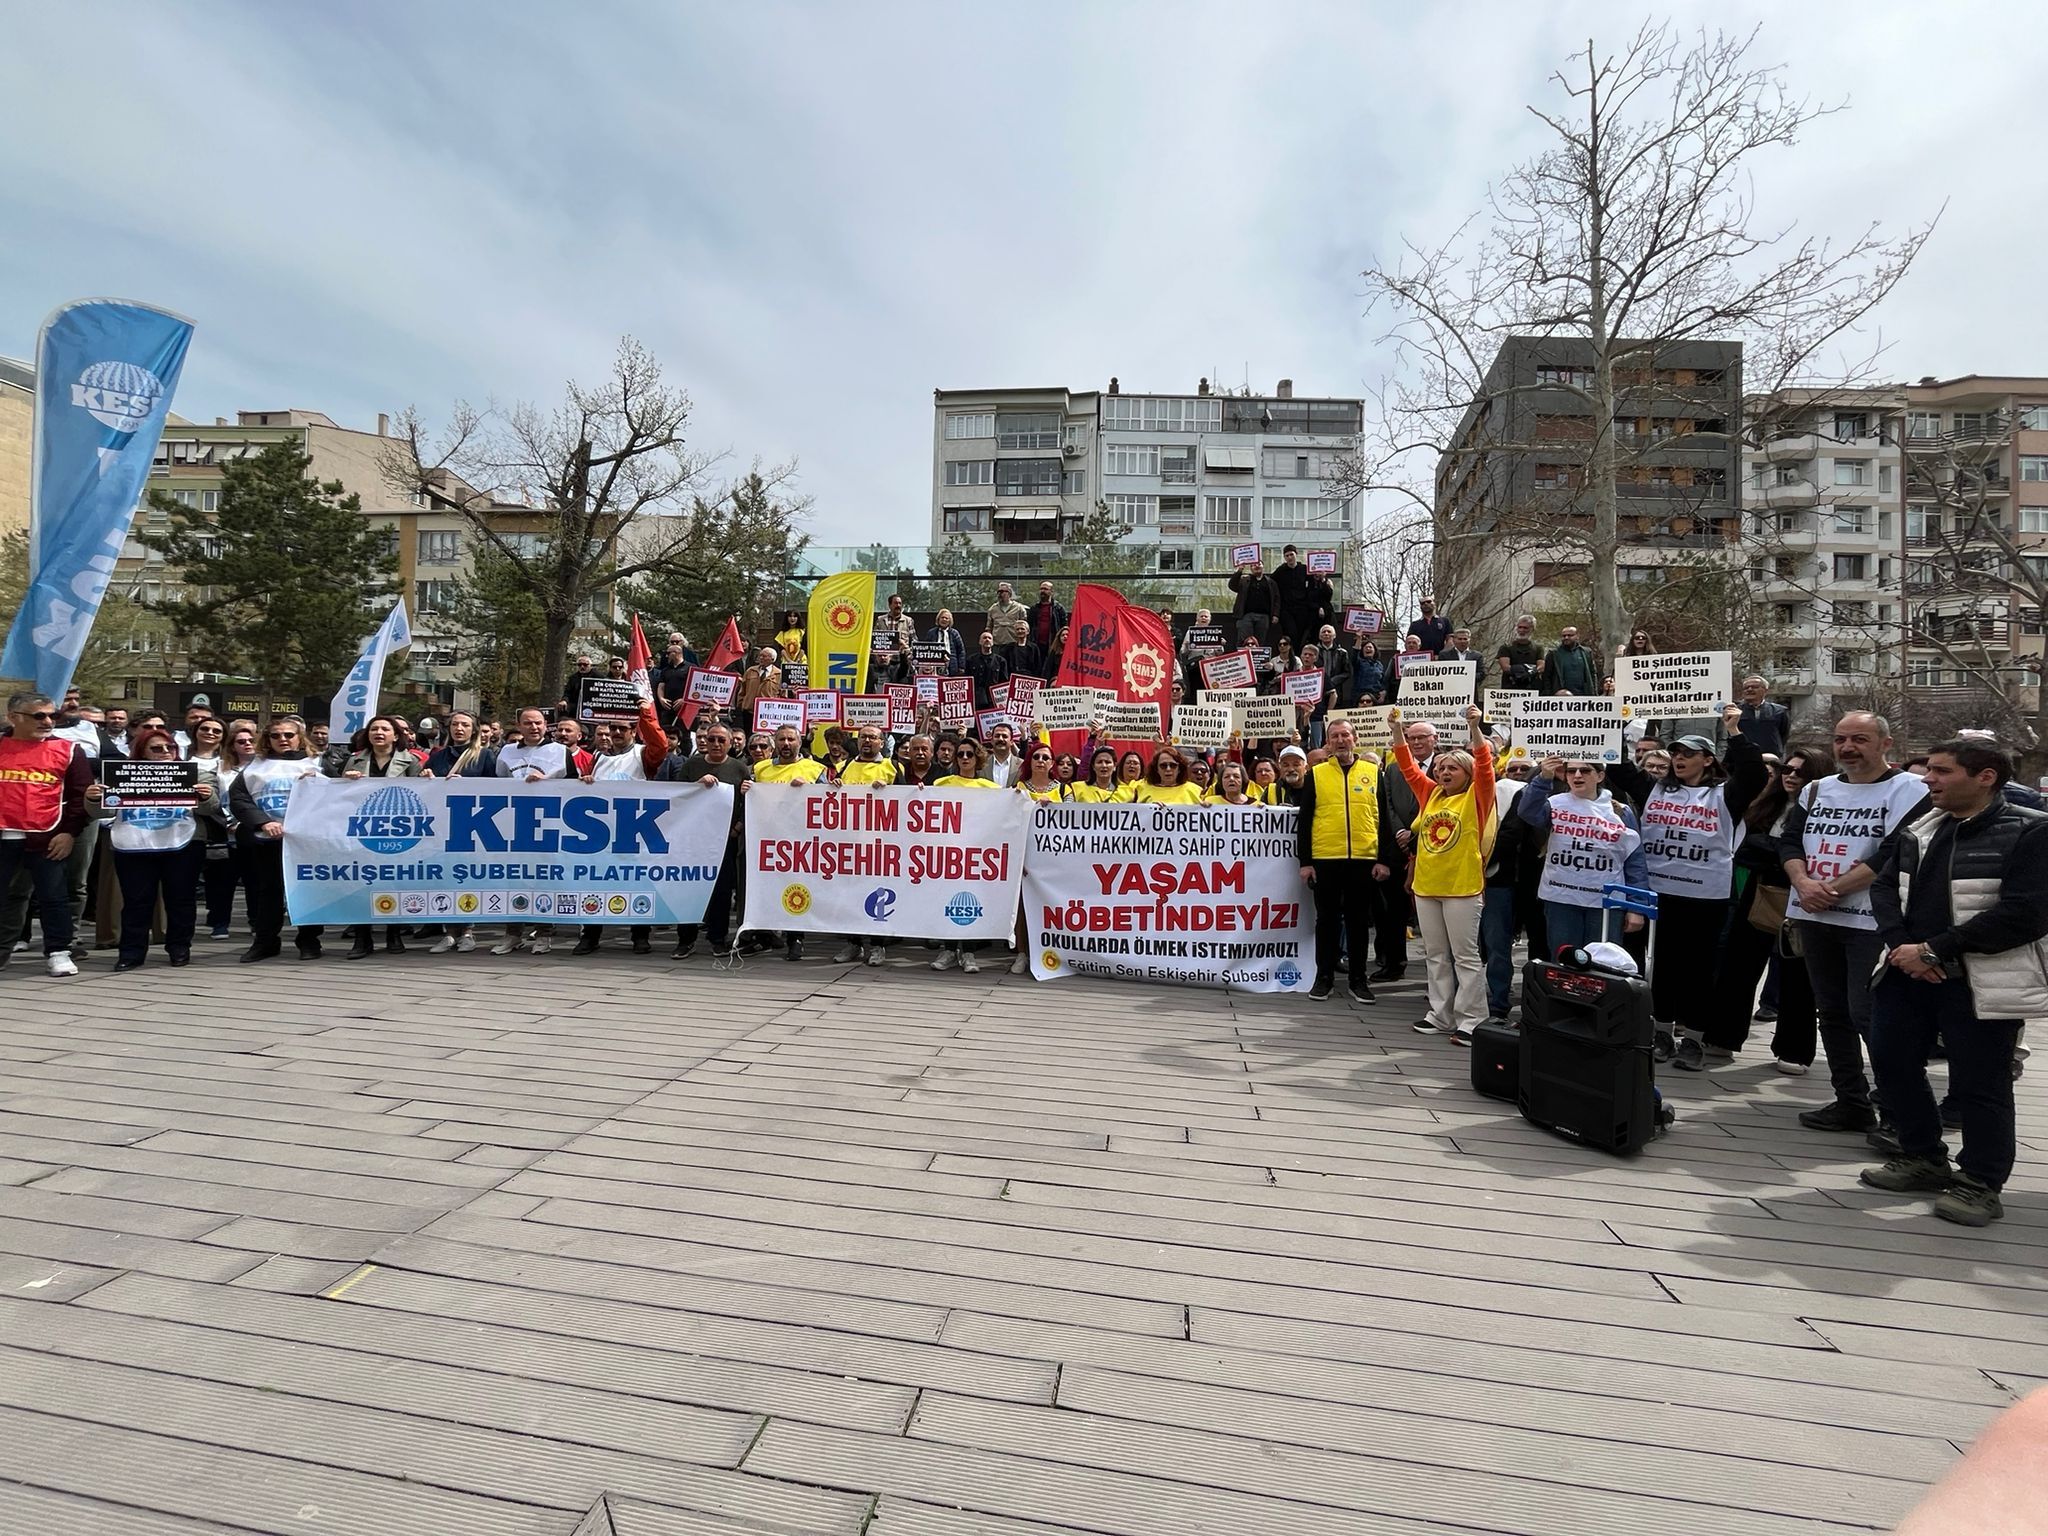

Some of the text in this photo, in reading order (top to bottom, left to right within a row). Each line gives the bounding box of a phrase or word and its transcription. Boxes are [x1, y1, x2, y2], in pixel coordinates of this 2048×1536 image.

[1632, 655, 1711, 669] Bu şiddetin
[828, 652, 859, 694] EN
[1633, 668, 1709, 681] Sorumlusu
[944, 680, 967, 690] YUSUF
[1016, 679, 1039, 690] YUSUF
[1413, 681, 1444, 692] Bakan
[1650, 681, 1692, 692] Yanlış
[891, 688, 911, 698] YUSUF
[946, 689, 966, 701] TEKİN
[1039, 689, 1074, 698] Yaşatmak
[1204, 691, 1232, 703] Vizyon
[1623, 691, 1722, 705] Politikalardır !
[1234, 697, 1269, 708] Güvenli
[1427, 694, 1471, 706] bakıyor!
[1494, 701, 1511, 709] Şidd
[940, 701, 973, 719] İSTİFA
[1053, 705, 1077, 713] Ölmek
[1177, 707, 1228, 717] Okulda Can
[1246, 708, 1282, 719] Güvenli
[1522, 700, 1613, 714] Şiddet varken
[1635, 708, 1651, 718] Eğitim
[1652, 707, 1662, 716] Sen
[1664, 706, 1689, 717] Eskişehir
[1690, 705, 1709, 716] Şubesi
[893, 708, 914, 723] TİFA
[1104, 714, 1138, 723] Çocukları
[1181, 717, 1226, 729] Güvenliği
[1244, 719, 1286, 730] Gelecek!
[1514, 717, 1621, 730] başarı masalları
[1527, 733, 1605, 746] anlatmayın!
[1530, 749, 1545, 760] Eğitim
[1581, 750, 1600, 761] Şubesi
[806, 791, 963, 835] EĞİTİM SEN
[346, 816, 435, 836] KESK
[445, 795, 671, 855] KESK
[1034, 808, 1146, 832] OKULUMUZA,
[1550, 808, 1627, 832] ÖĞRETMEN
[1646, 814, 1718, 832] SENDİKASI
[1665, 826, 1689, 842] İLE
[1805, 821, 1885, 838] ENDİKAS
[377, 841, 403, 851] 1995
[1034, 834, 1300, 861] YAŞAM HAKKIMIZA SAHİP ÇIKIYORU
[1571, 837, 1595, 852] İLE
[1643, 839, 1710, 862] GÜÇLÜ!
[1819, 838, 1848, 856] İLE
[758, 836, 1009, 885] ESKİŞEHİR ŞUBESİ
[1550, 849, 1613, 872] GÜÇLÜ!
[296, 861, 718, 886] ESKİŞEHİR ŞUBELER PLATFORMU
[1092, 860, 1246, 904] YAŞAM
[559, 905, 575, 914] BTS
[944, 906, 983, 917] KESK
[1043, 897, 1299, 933] NÖBETİNDEYİZ!
[1040, 931, 1130, 955] OKULLARDA
[1133, 936, 1187, 958] ÖLMEK
[1067, 959, 1269, 985] Eğitim Sen Eskişehir Şubesi
[1274, 971, 1302, 980] KESK
